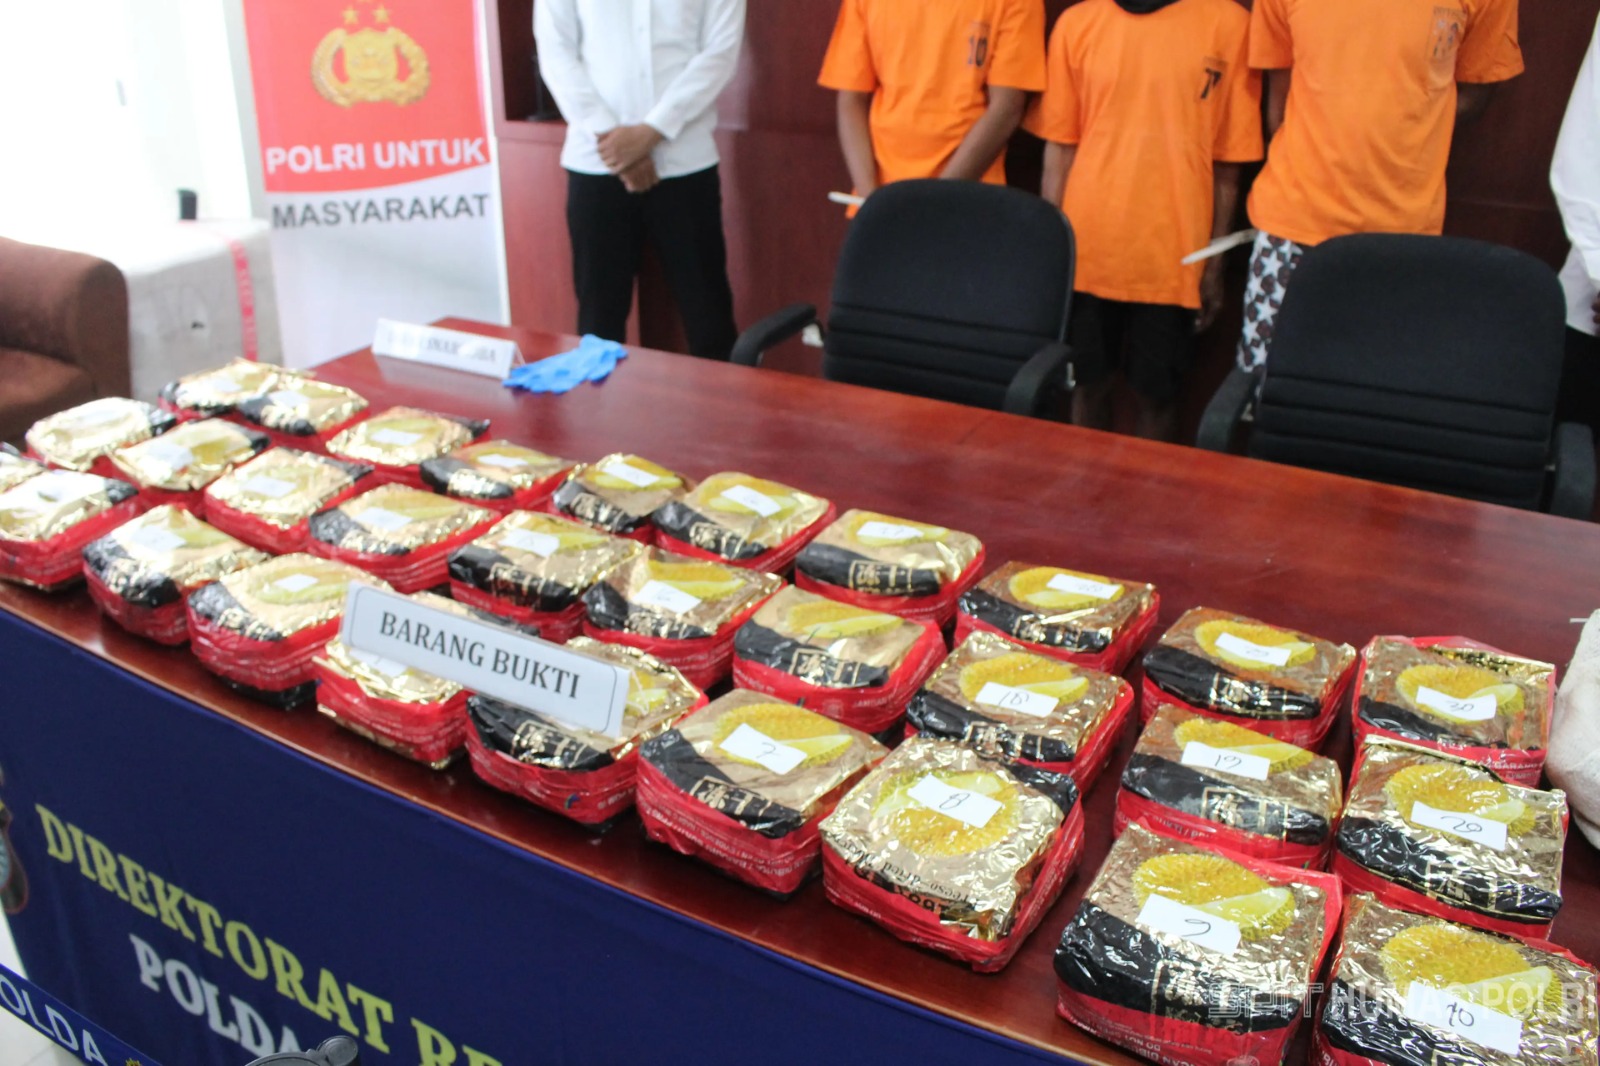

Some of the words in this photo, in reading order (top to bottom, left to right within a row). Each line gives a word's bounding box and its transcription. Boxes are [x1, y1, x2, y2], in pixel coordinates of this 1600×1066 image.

[266, 142, 366, 174] POLRI
[373, 137, 487, 169] UNTUK
[271, 193, 489, 230] MASYARAKAT
[378, 611, 485, 667] BARANG
[491, 648, 581, 700] BUKTI
[35, 803, 394, 1055] DIREKTORAT
